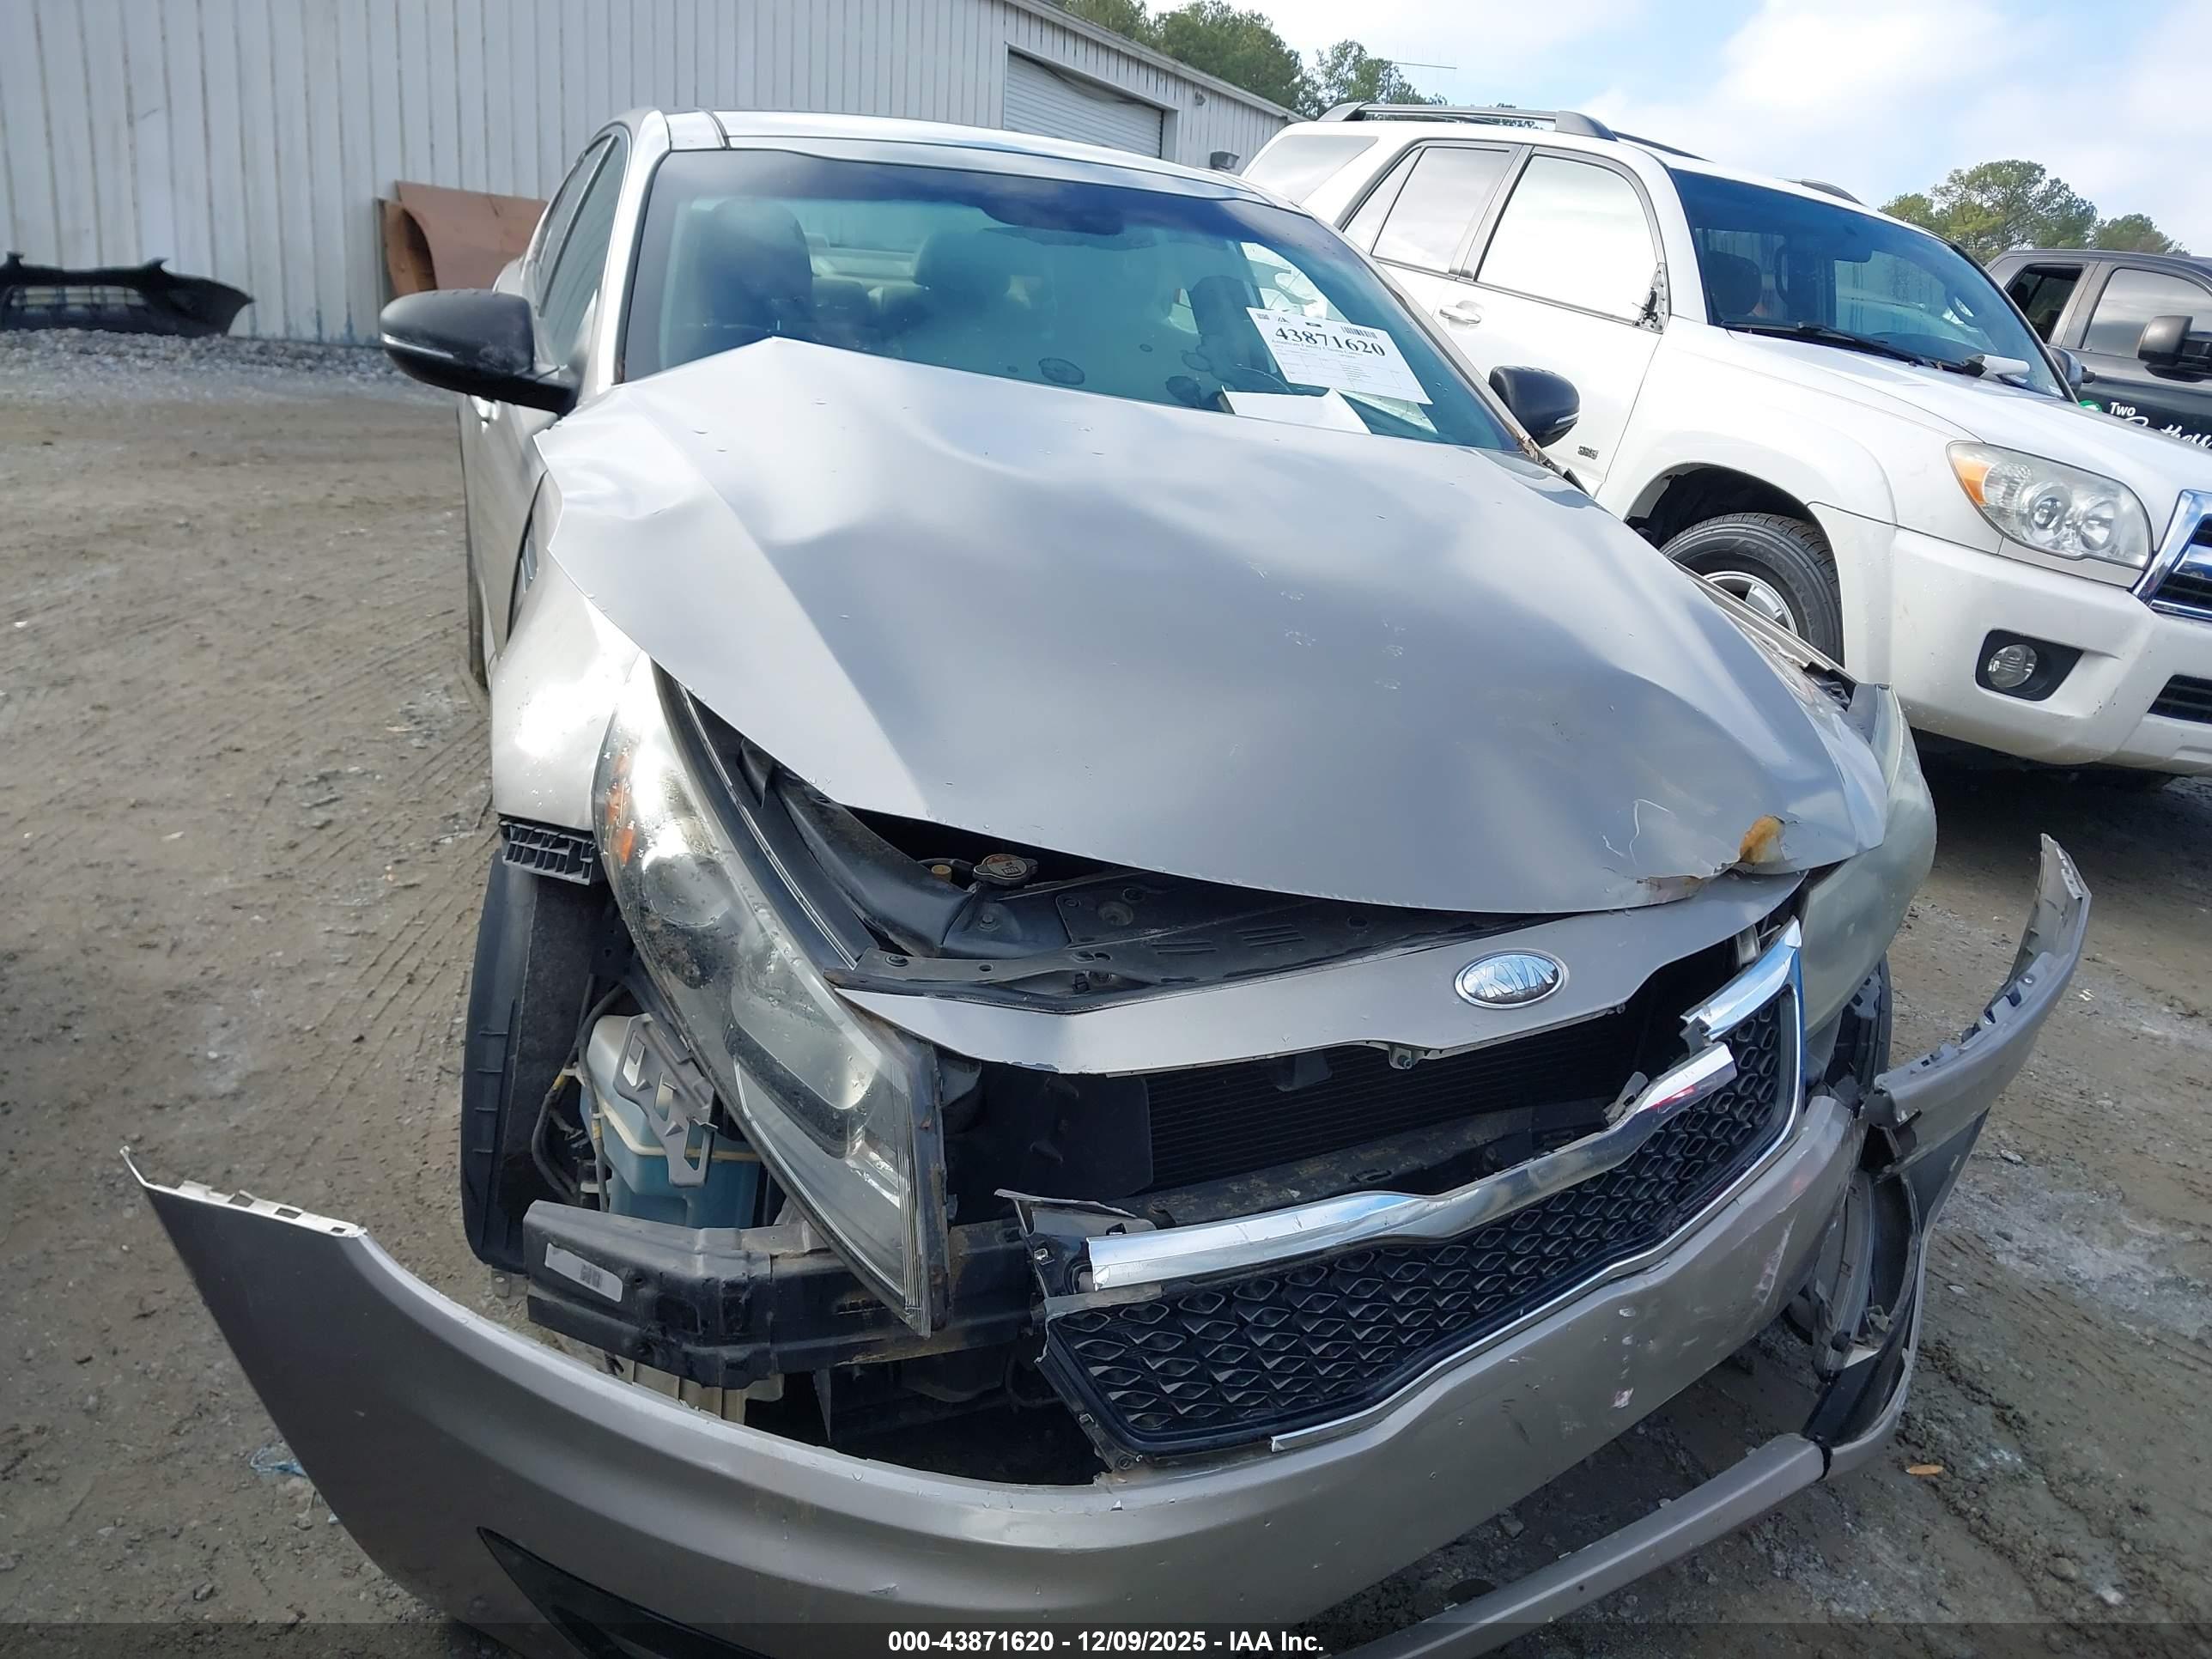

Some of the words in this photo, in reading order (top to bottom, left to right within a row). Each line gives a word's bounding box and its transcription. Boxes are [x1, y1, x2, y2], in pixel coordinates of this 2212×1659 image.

[1275, 327, 1385, 356] 43871620
[2110, 401, 2136, 416] Two
[1473, 957, 1554, 999] KIA
